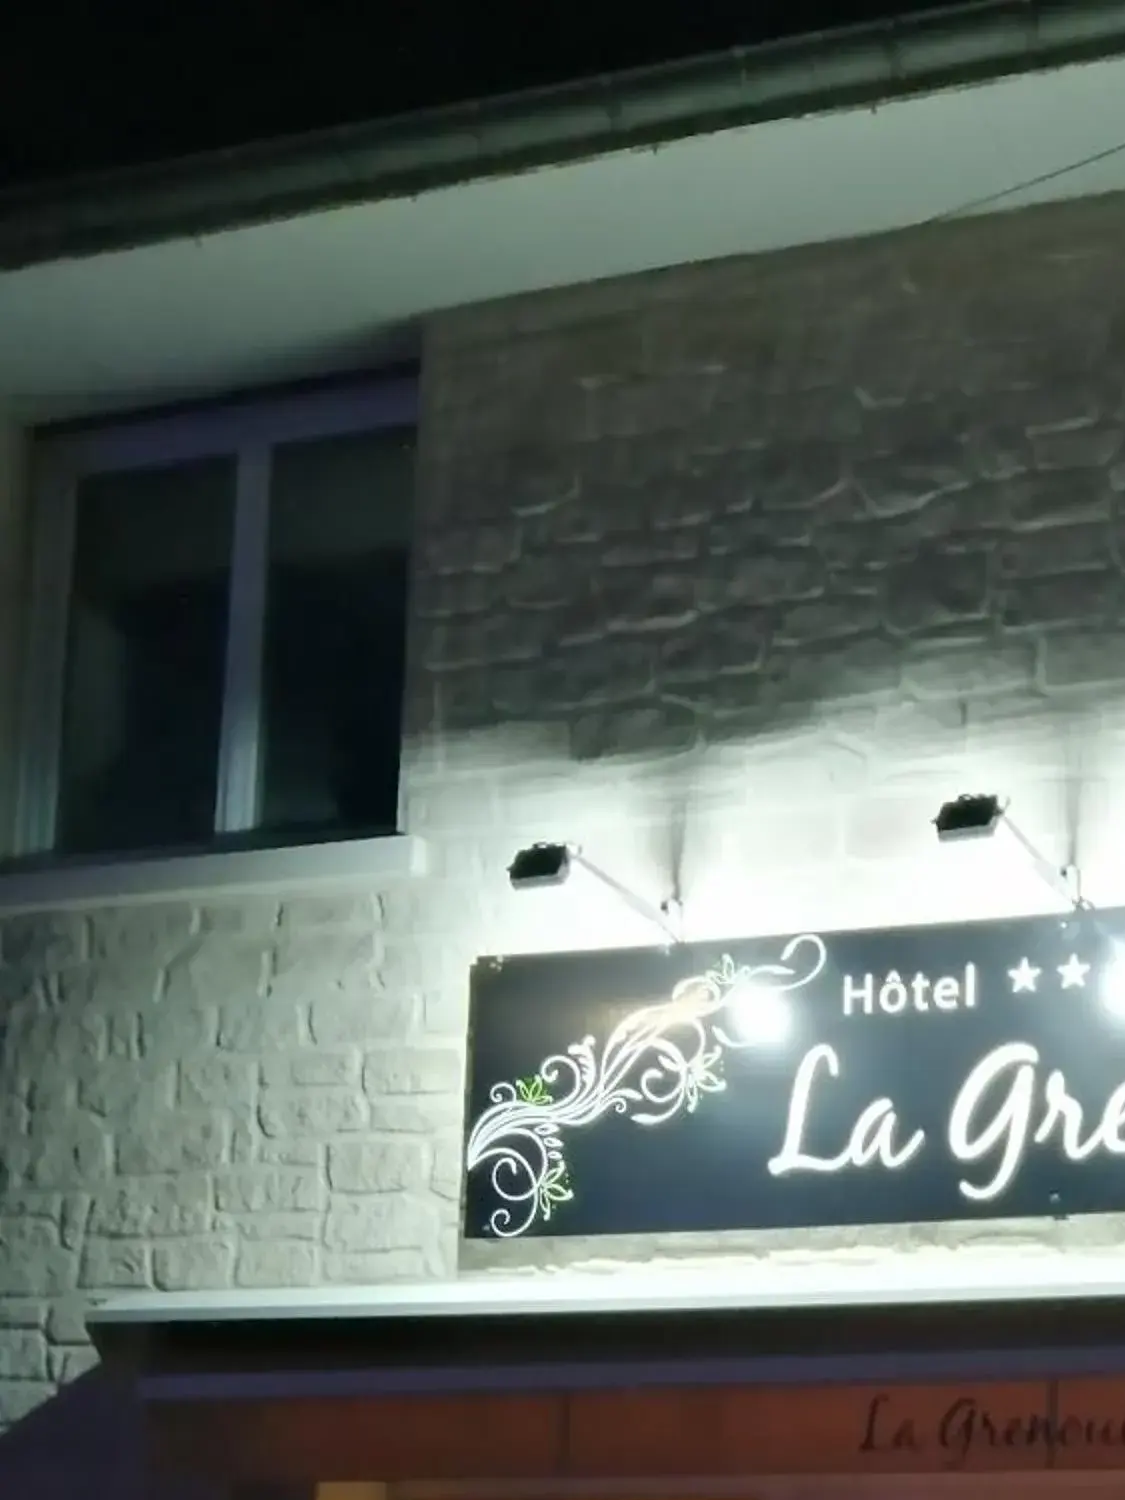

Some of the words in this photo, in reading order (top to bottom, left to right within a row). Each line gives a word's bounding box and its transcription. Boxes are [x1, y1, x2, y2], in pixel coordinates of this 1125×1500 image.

[841, 962, 977, 1015] Hôtel
[766, 1043, 926, 1177] La
[858, 1391, 924, 1453] La
